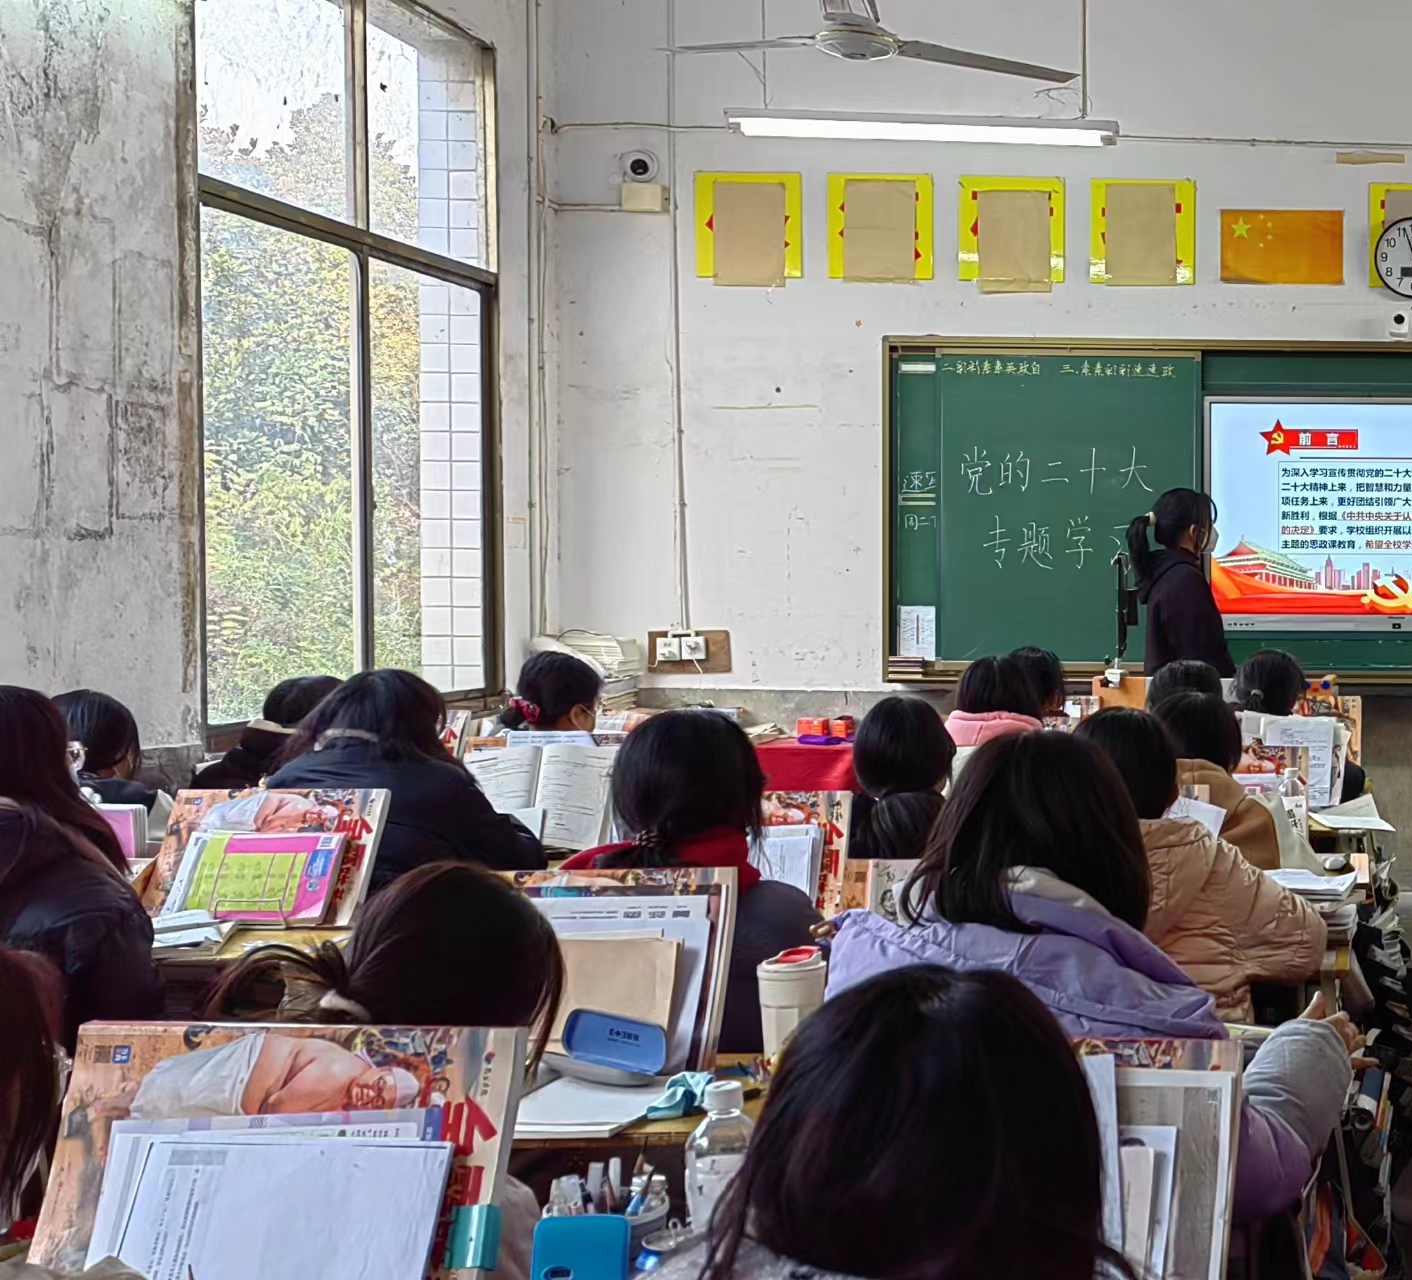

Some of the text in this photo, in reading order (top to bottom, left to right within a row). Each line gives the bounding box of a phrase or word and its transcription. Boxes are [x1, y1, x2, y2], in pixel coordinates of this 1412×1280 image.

[1386, 238, 1396, 247] 10
[1381, 252, 1388, 262] 9
[1386, 267, 1392, 276] 8
[1397, 277, 1403, 287] 7
[960, 446, 1153, 495] 党的二十大
